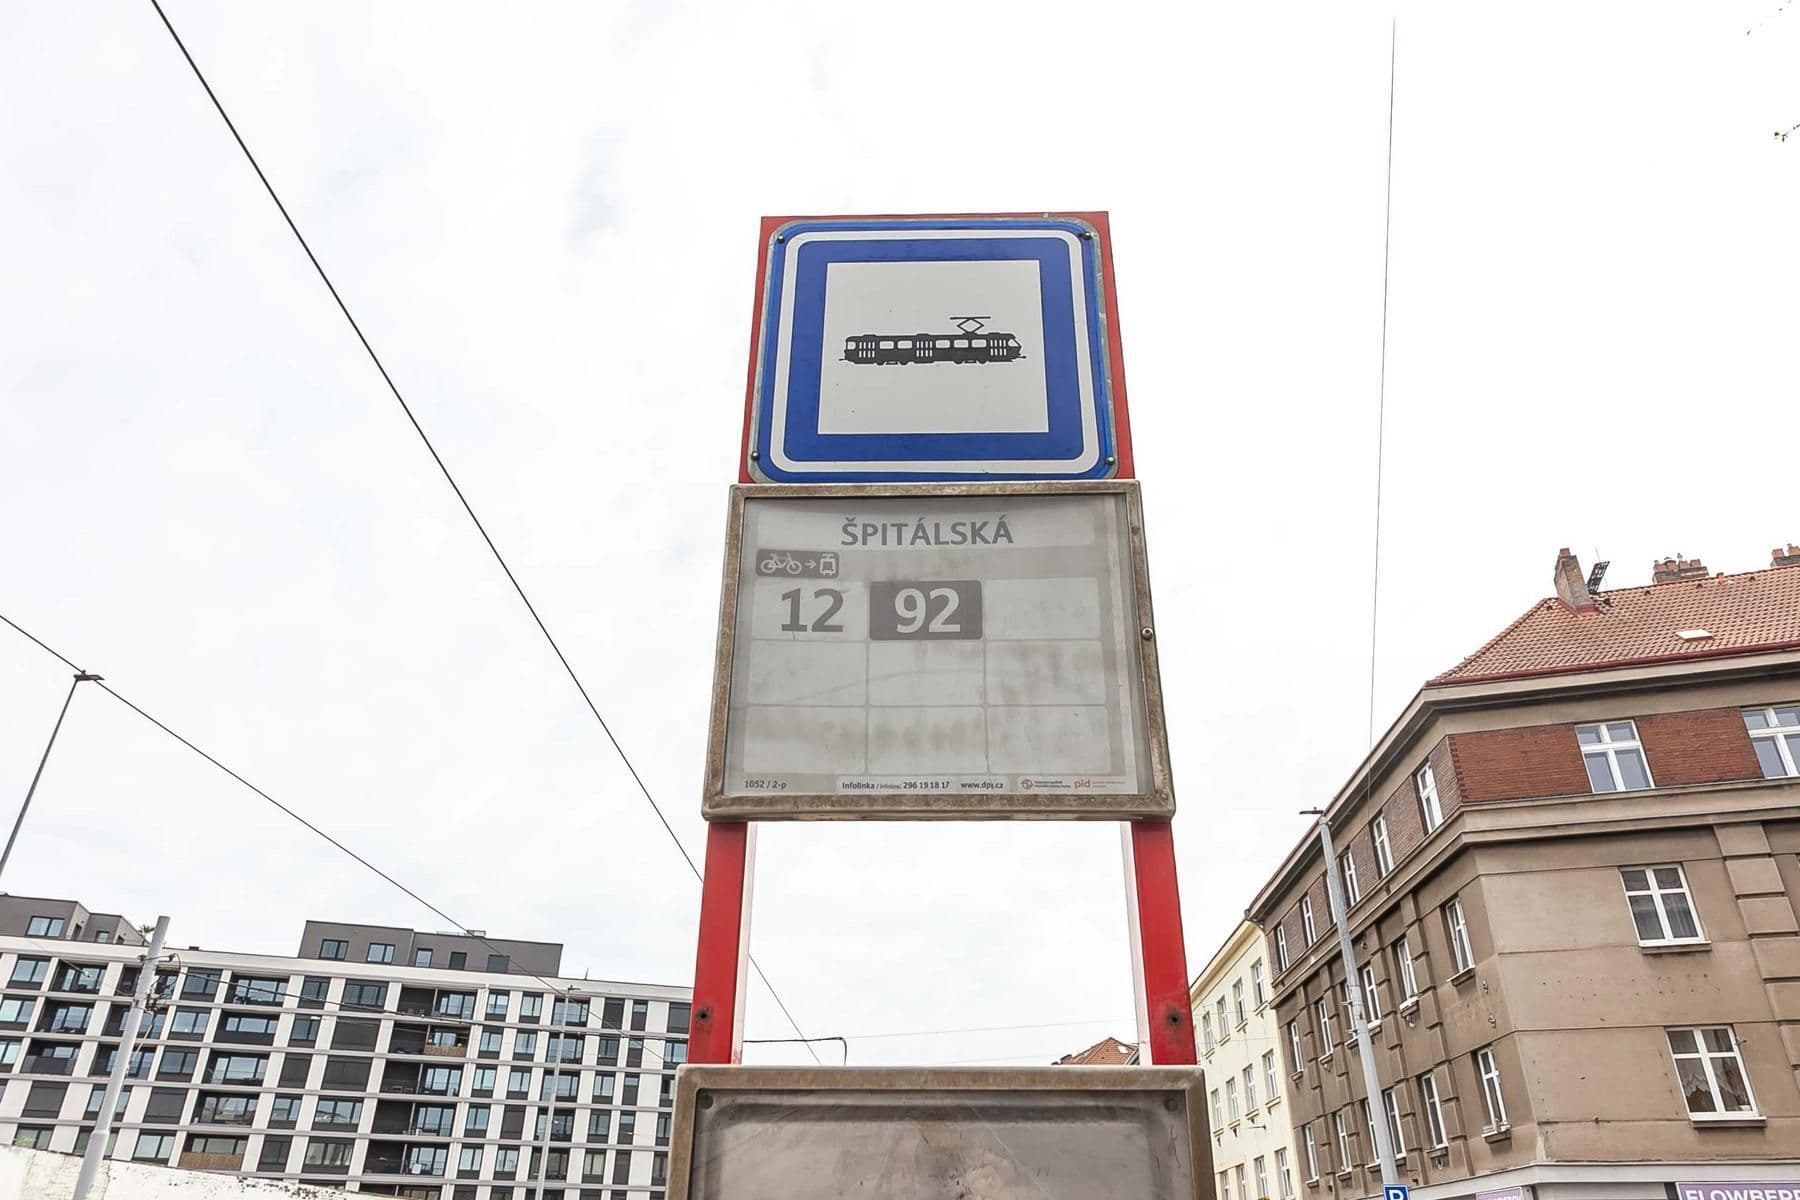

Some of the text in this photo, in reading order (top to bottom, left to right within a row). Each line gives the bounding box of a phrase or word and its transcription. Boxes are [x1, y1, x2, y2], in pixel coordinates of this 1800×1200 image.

[840, 514, 1014, 546] ŠPITÁLSKÁ
[780, 587, 961, 634] 12 92
[744, 780, 765, 789] 1052
[772, 780, 787, 790] 2-p
[903, 781, 918, 789] 296
[919, 781, 929, 789] 19
[930, 781, 940, 789] 18
[941, 781, 950, 789] 17
[1388, 1189, 1405, 1200] P
